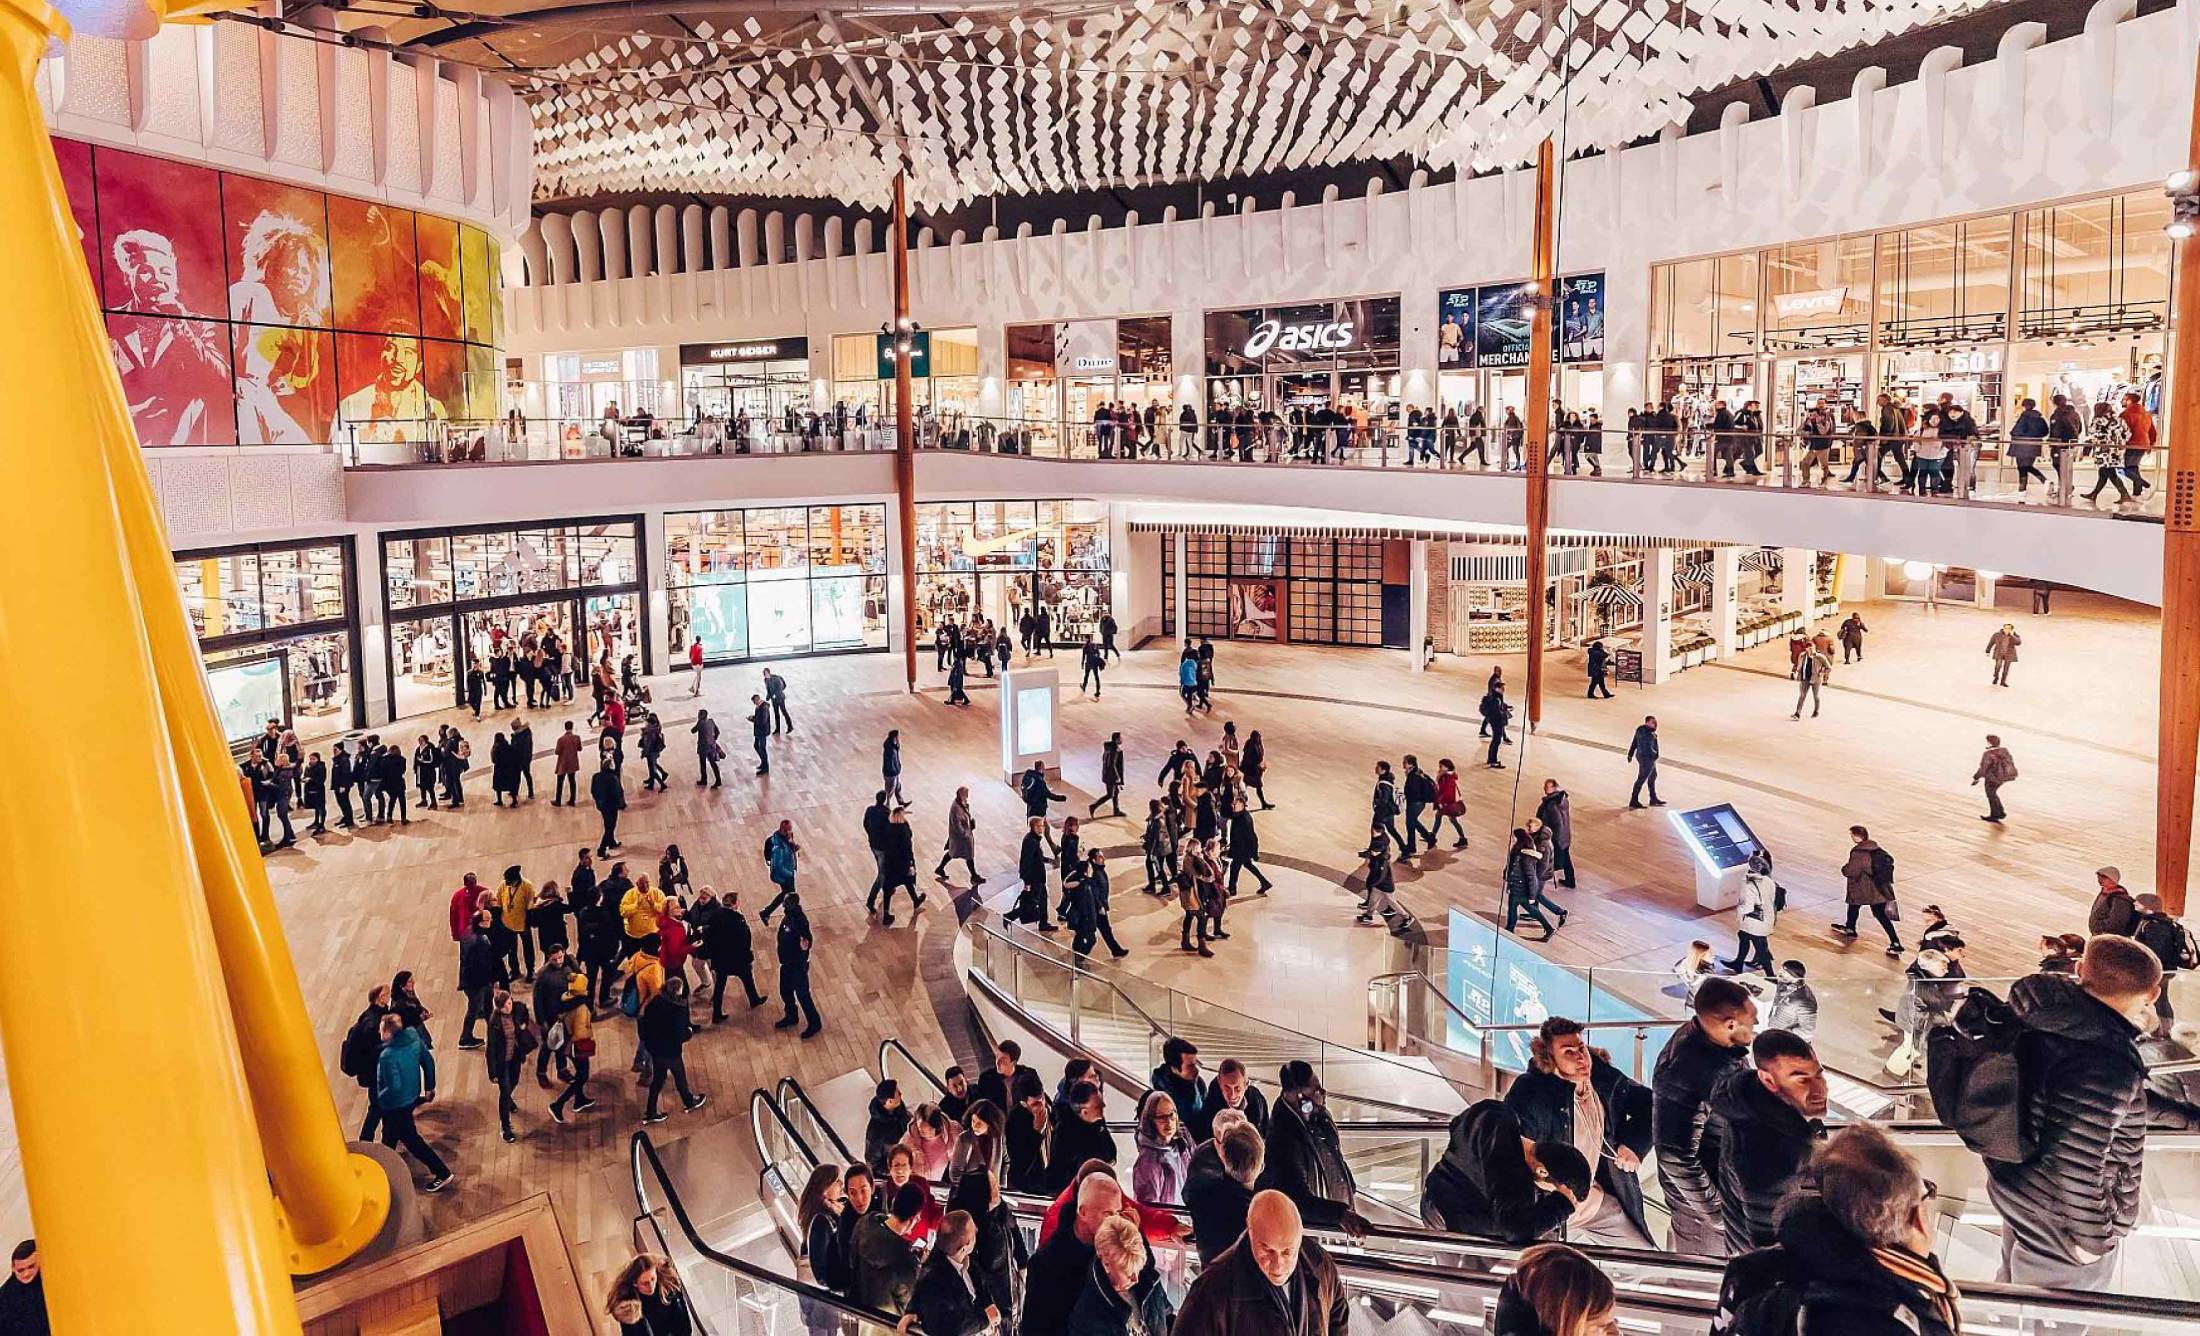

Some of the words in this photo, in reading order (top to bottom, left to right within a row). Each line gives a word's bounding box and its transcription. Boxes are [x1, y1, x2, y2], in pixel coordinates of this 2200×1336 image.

[710, 348, 737, 358] KURT
[738, 346, 777, 357] GEIGER
[1502, 343, 1530, 353] OFFICIA
